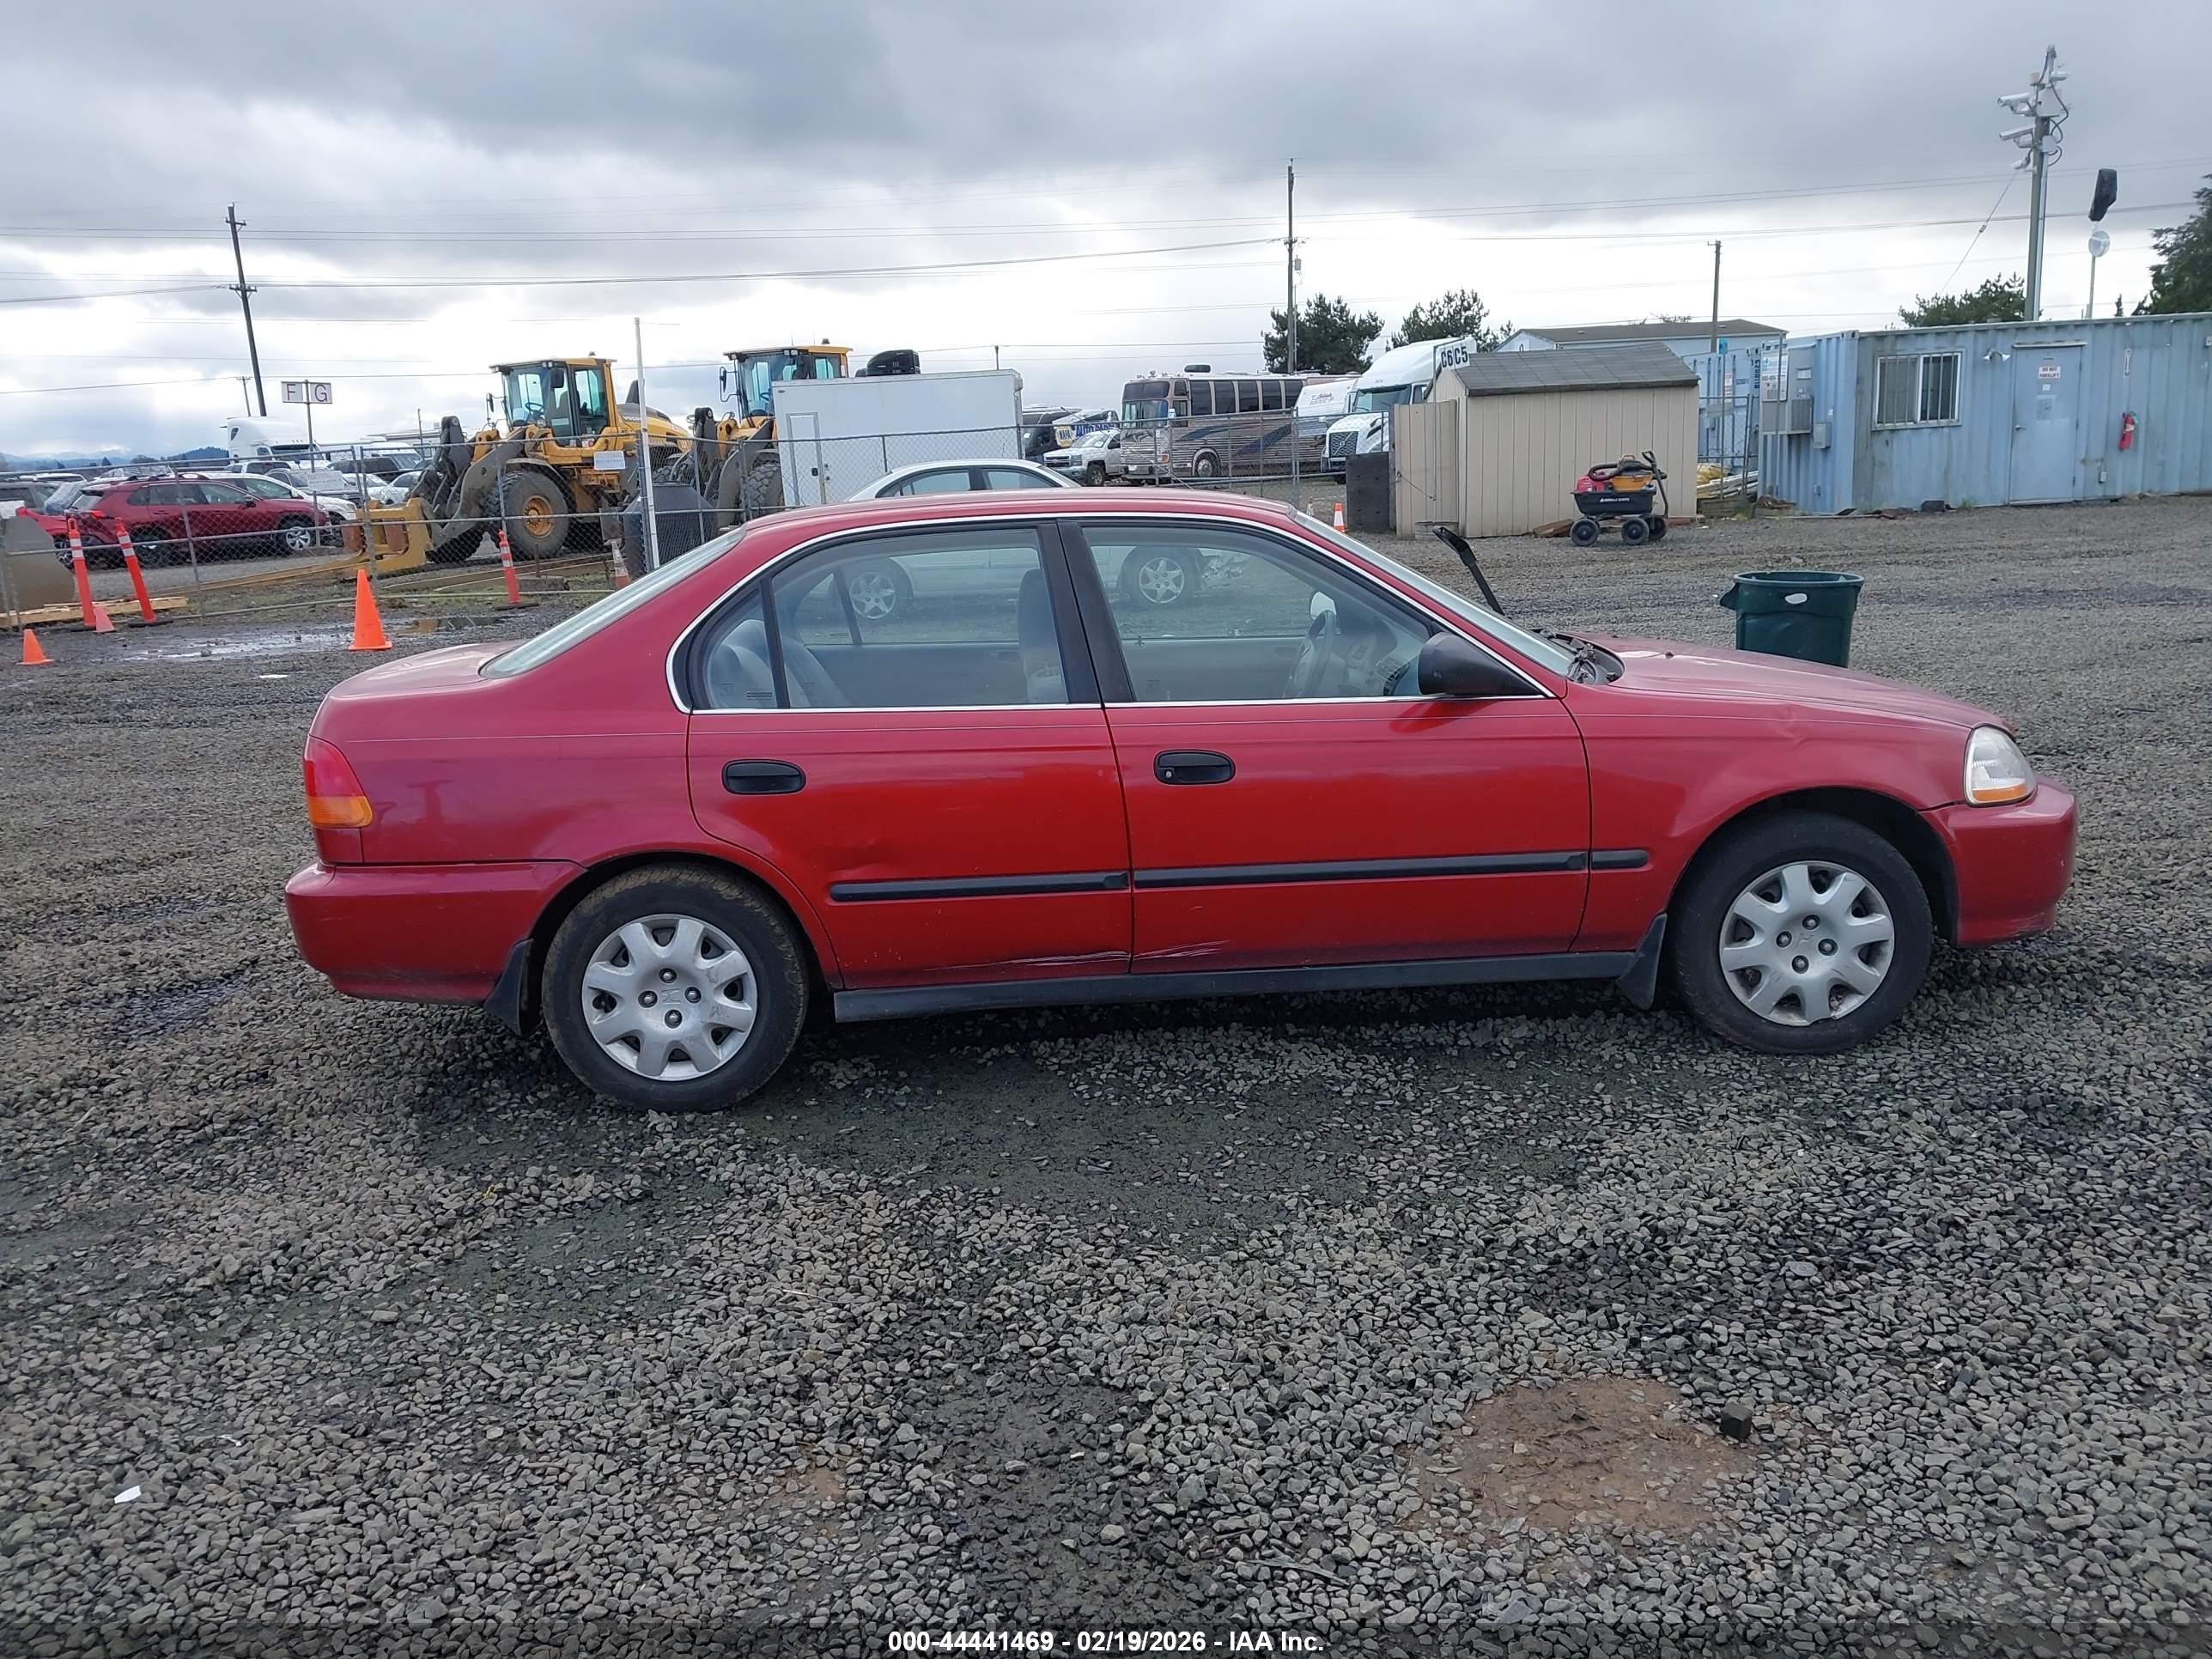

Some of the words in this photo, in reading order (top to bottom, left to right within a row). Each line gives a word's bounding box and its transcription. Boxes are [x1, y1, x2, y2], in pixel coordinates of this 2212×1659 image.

[1441, 349, 1453, 368] C6
[1454, 345, 1468, 365] C5
[286, 383, 296, 401] F
[314, 384, 328, 402] G
